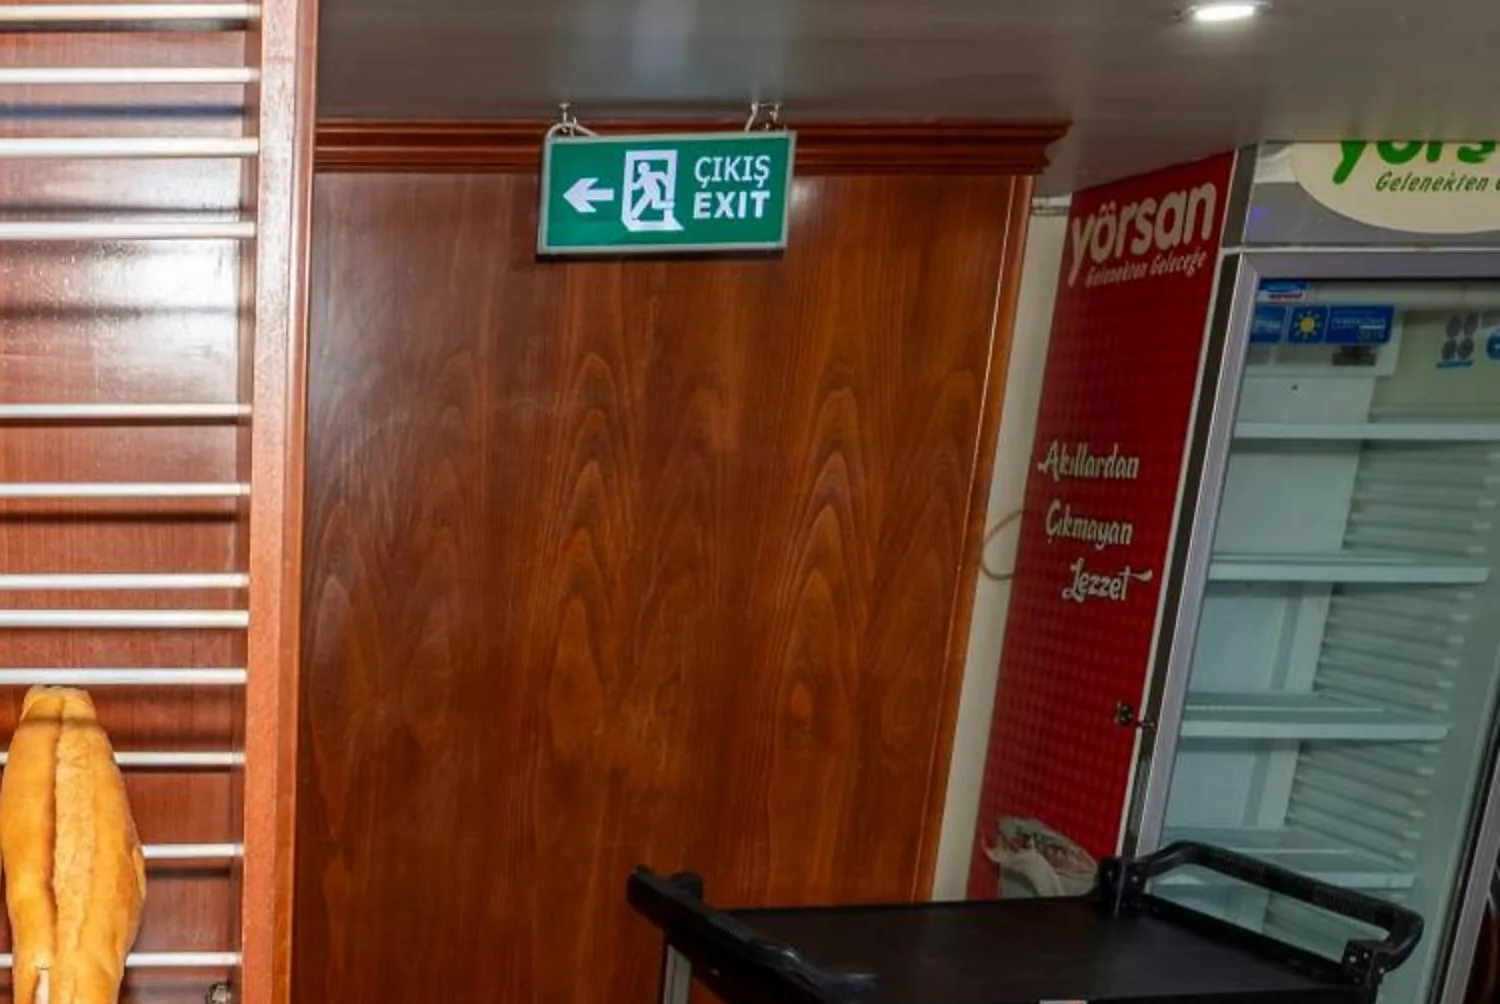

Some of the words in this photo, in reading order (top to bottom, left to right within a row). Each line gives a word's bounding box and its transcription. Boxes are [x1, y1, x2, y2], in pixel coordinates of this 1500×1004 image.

[694, 154, 770, 188] ÇIKIŞ
[693, 190, 771, 219] EXIT
[1067, 182, 1217, 288] yörsan
[1061, 557, 1153, 602] Lezzet
